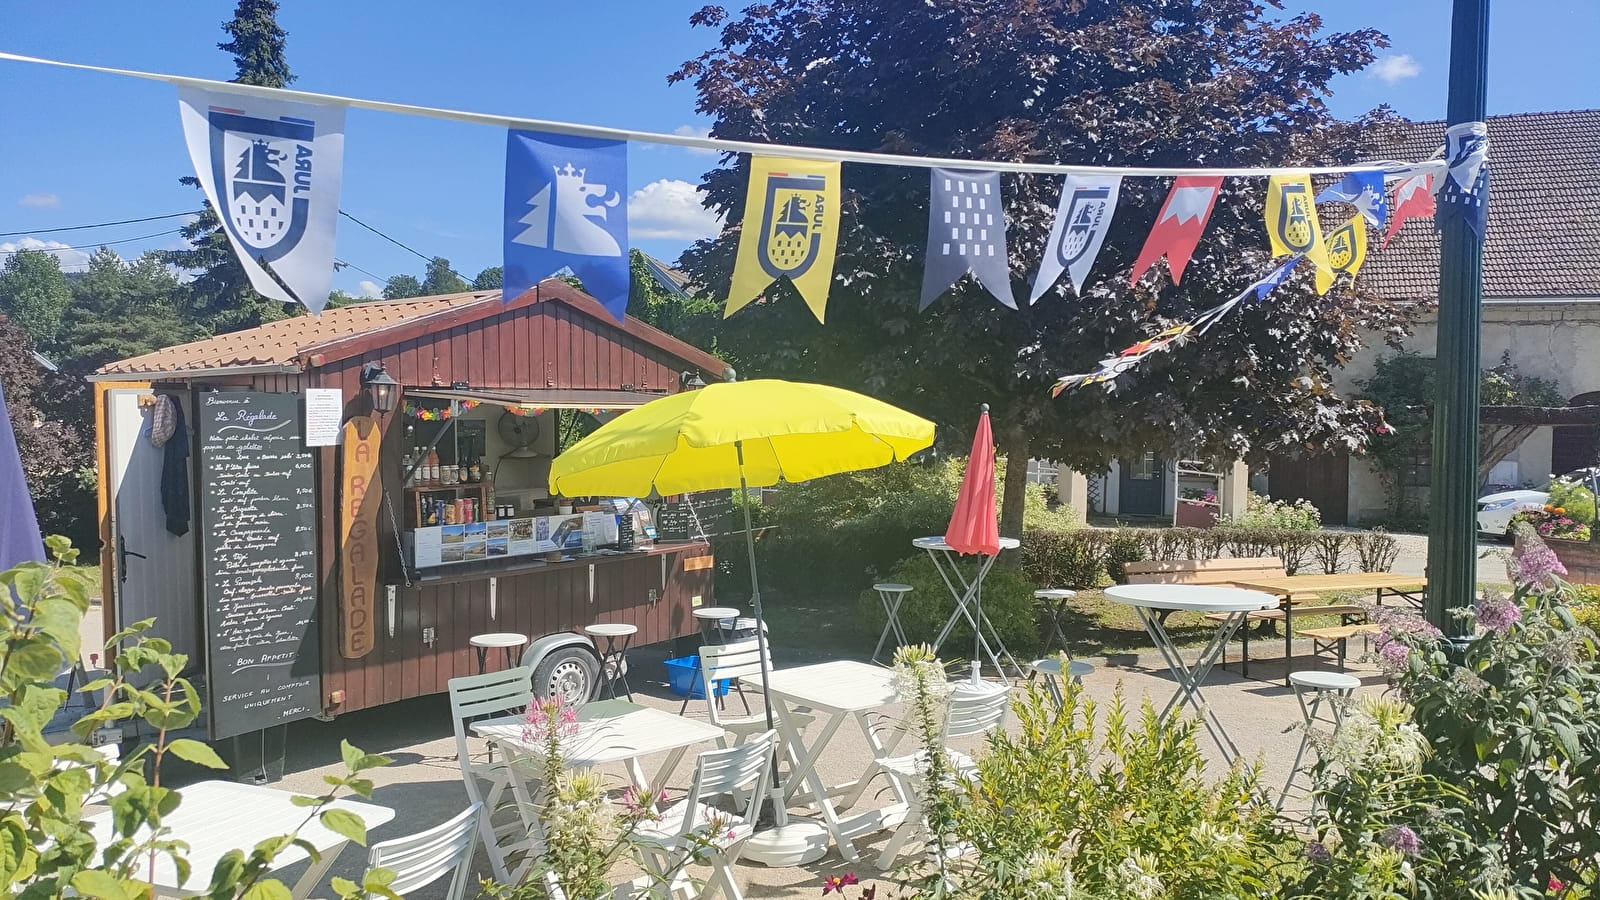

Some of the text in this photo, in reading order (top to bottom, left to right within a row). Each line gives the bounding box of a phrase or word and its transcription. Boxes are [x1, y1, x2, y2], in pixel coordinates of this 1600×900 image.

[215, 409, 278, 427] La Régalade
[236, 657, 255, 667] BON
[222, 691, 254, 703] SERVICE
[277, 680, 311, 691] COMPTOIR
[243, 694, 293, 709] UNIQUEMENT
[282, 706, 306, 718] MERCI
